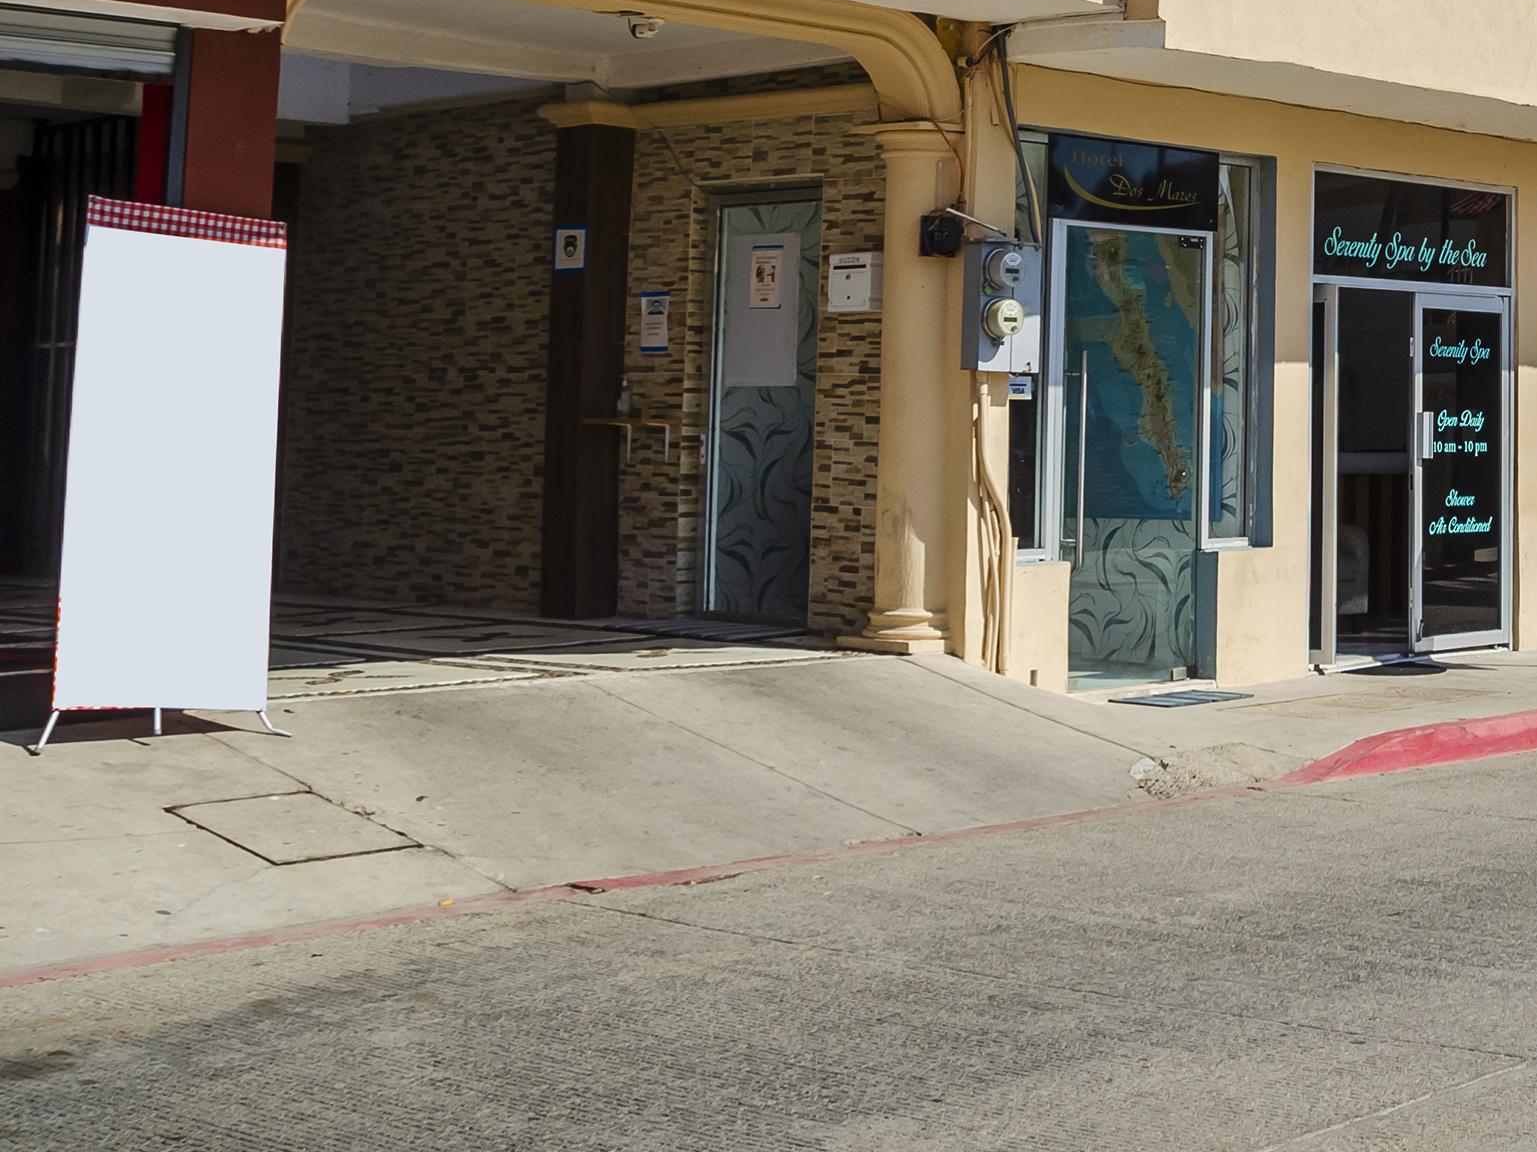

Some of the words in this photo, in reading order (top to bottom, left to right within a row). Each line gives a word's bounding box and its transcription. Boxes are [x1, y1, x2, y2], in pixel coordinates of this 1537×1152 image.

[1072, 150, 1124, 168] Hotel
[1109, 173, 1144, 198] Dos
[1147, 179, 1199, 202] Mares
[1324, 226, 1382, 268] Serenity
[1385, 232, 1415, 269] Spa
[1418, 237, 1435, 272] by
[1438, 239, 1460, 265] the
[1460, 239, 1488, 268] Sea
[1429, 336, 1469, 365] Serenity
[1469, 338, 1491, 365] Spa
[1012, 387, 1025, 395] VISA
[1437, 409, 1458, 432] Open
[1459, 409, 1485, 432] Daily
[1433, 441, 1443, 453] 10
[1443, 442, 1456, 453] am
[1464, 441, 1474, 453] 10
[1474, 442, 1488, 457] pm
[1445, 489, 1475, 507] Shower
[1429, 516, 1447, 535] Air
[1448, 516, 1493, 534] Conditioned
